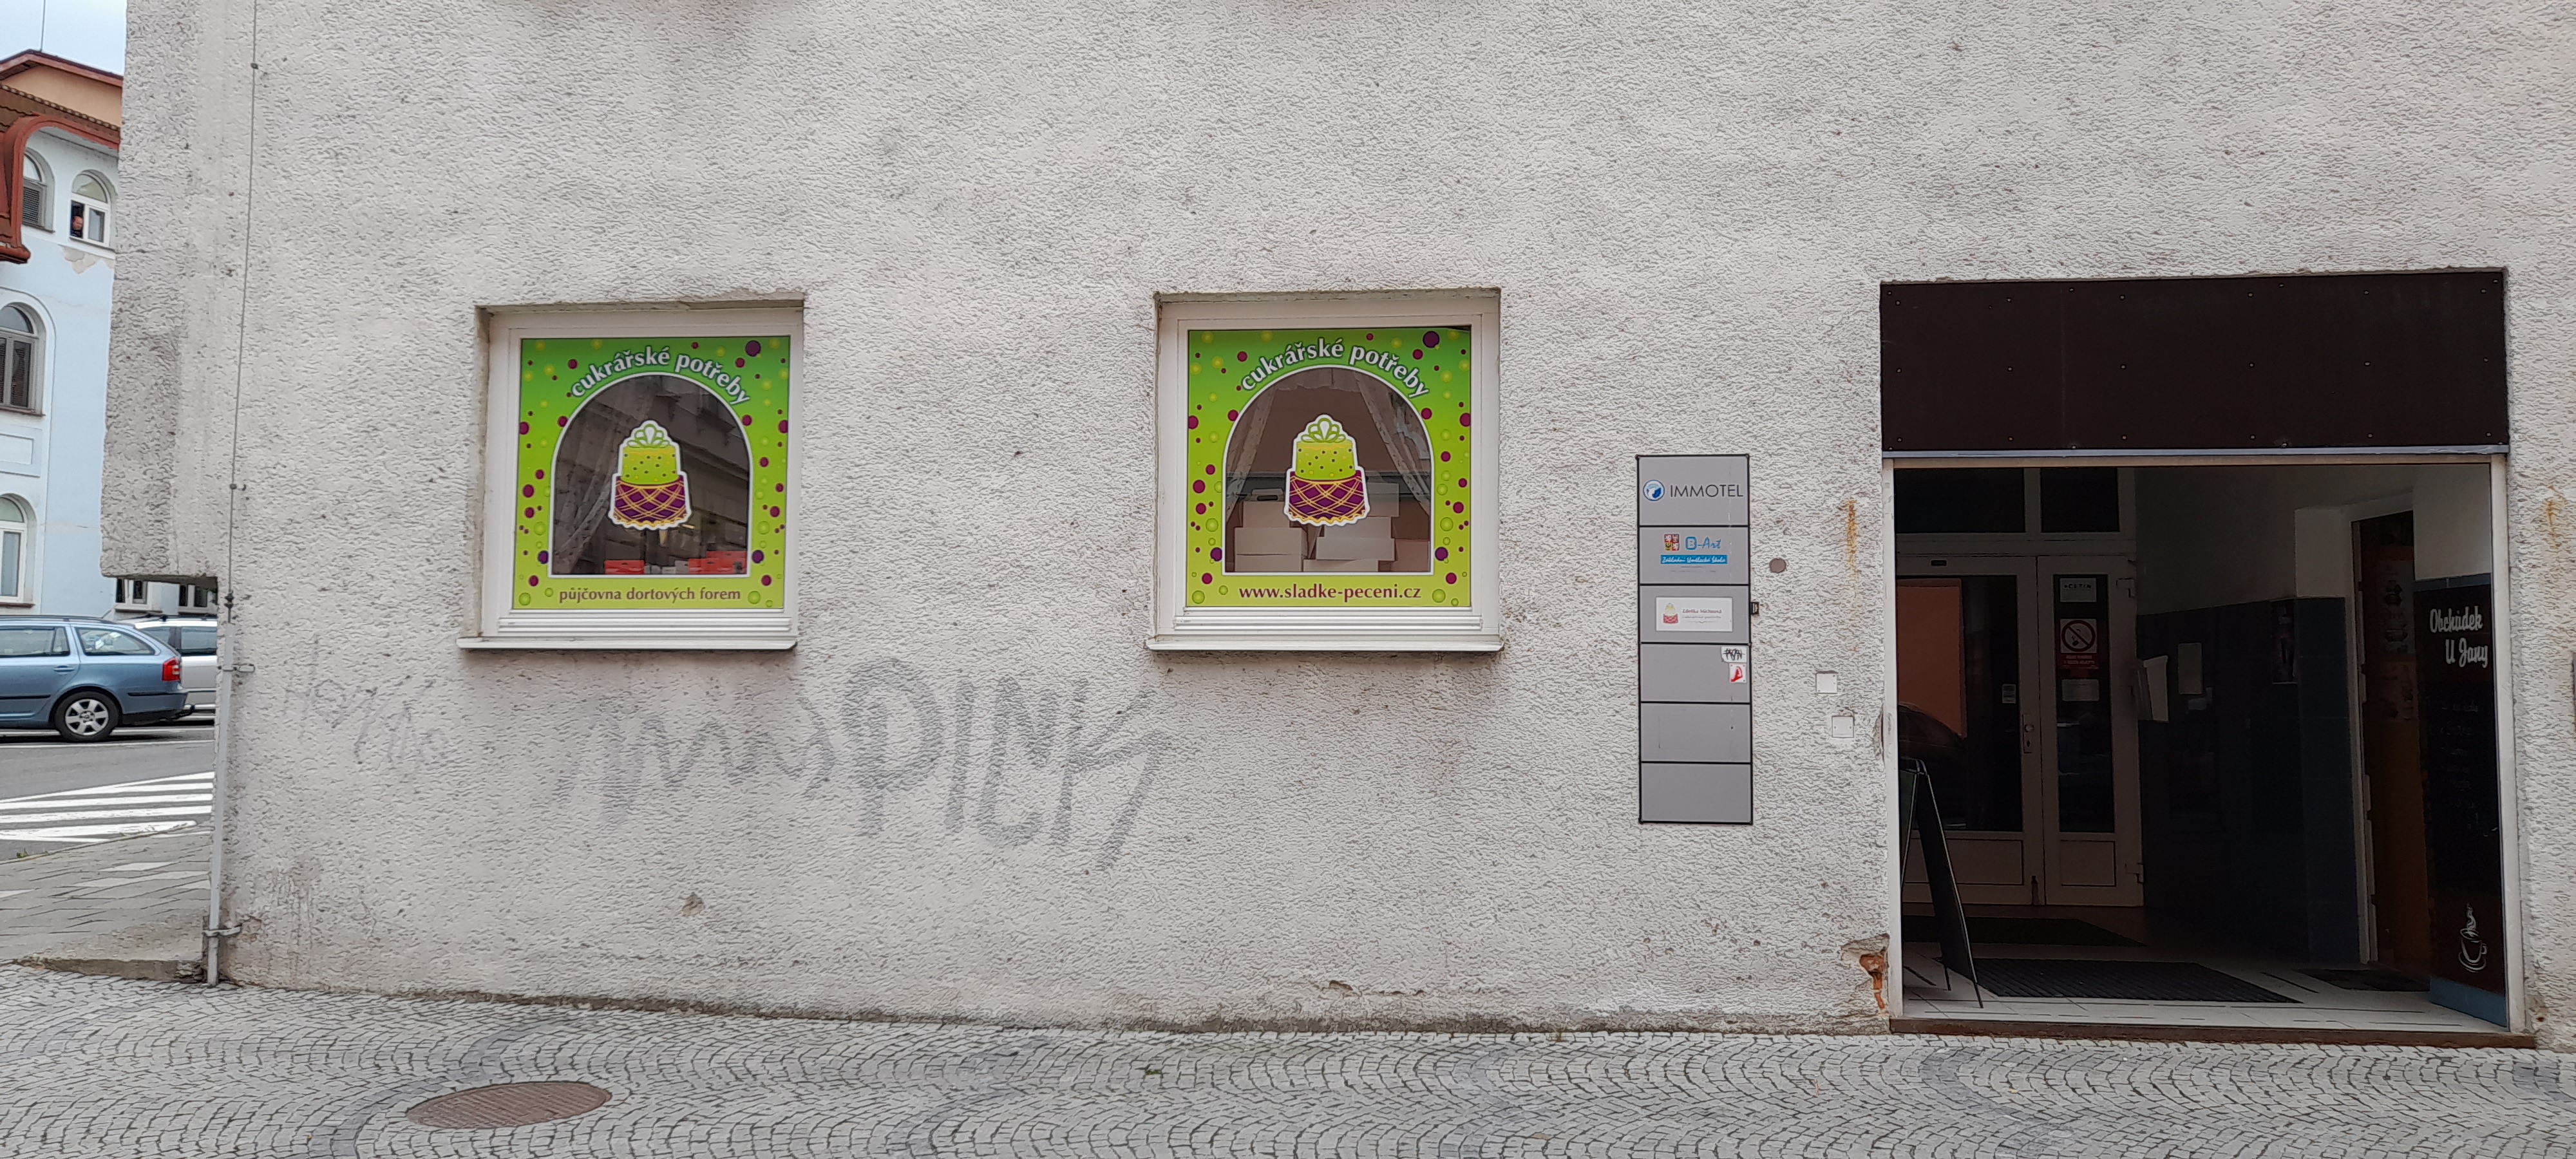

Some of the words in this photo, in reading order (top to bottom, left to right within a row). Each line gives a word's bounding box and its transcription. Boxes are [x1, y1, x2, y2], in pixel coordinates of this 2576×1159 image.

[571, 346, 670, 397] cukrářské
[674, 353, 751, 406] potřeby
[1242, 337, 1344, 391] cukrářské
[1350, 345, 1430, 399] potřeby
[1670, 484, 1744, 498] IMMOTEL
[558, 587, 621, 603] půjčovna
[626, 587, 695, 603] dortových
[699, 587, 741, 600] forem
[1238, 583, 1422, 602] www.sladke-peceni.cz
[2445, 638, 2457, 664] U
